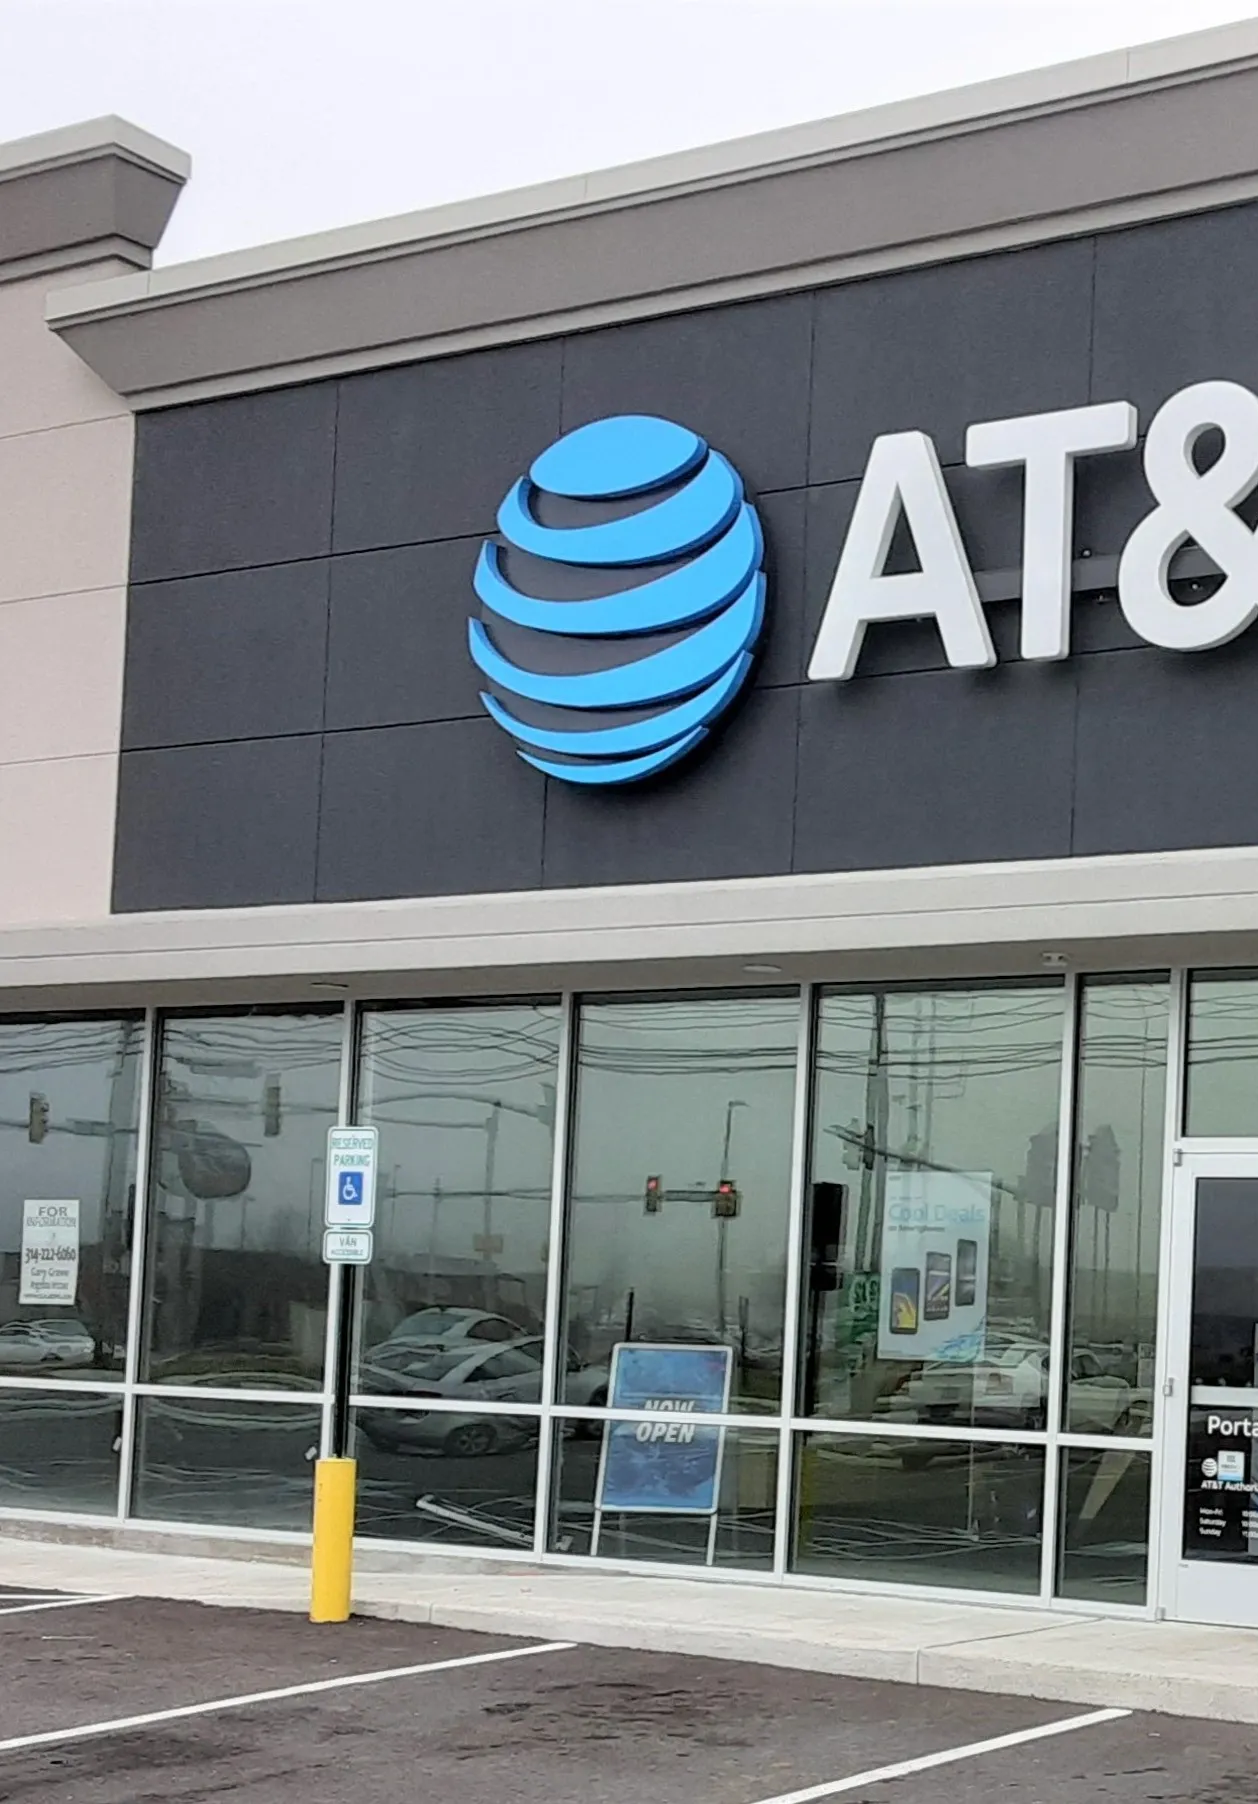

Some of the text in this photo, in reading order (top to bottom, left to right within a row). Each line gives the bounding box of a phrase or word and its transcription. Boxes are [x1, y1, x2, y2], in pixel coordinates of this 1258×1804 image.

[331, 1138, 373, 1150] RESERVED
[334, 1154, 371, 1167] PARKING
[38, 1206, 67, 1217] FOR
[888, 1203, 928, 1222] Cool
[339, 1235, 358, 1247] VAN
[635, 1421, 695, 1443] OPEN
[1201, 1480, 1222, 1490] AT&T
[1199, 1527, 1221, 1537] Sunday
